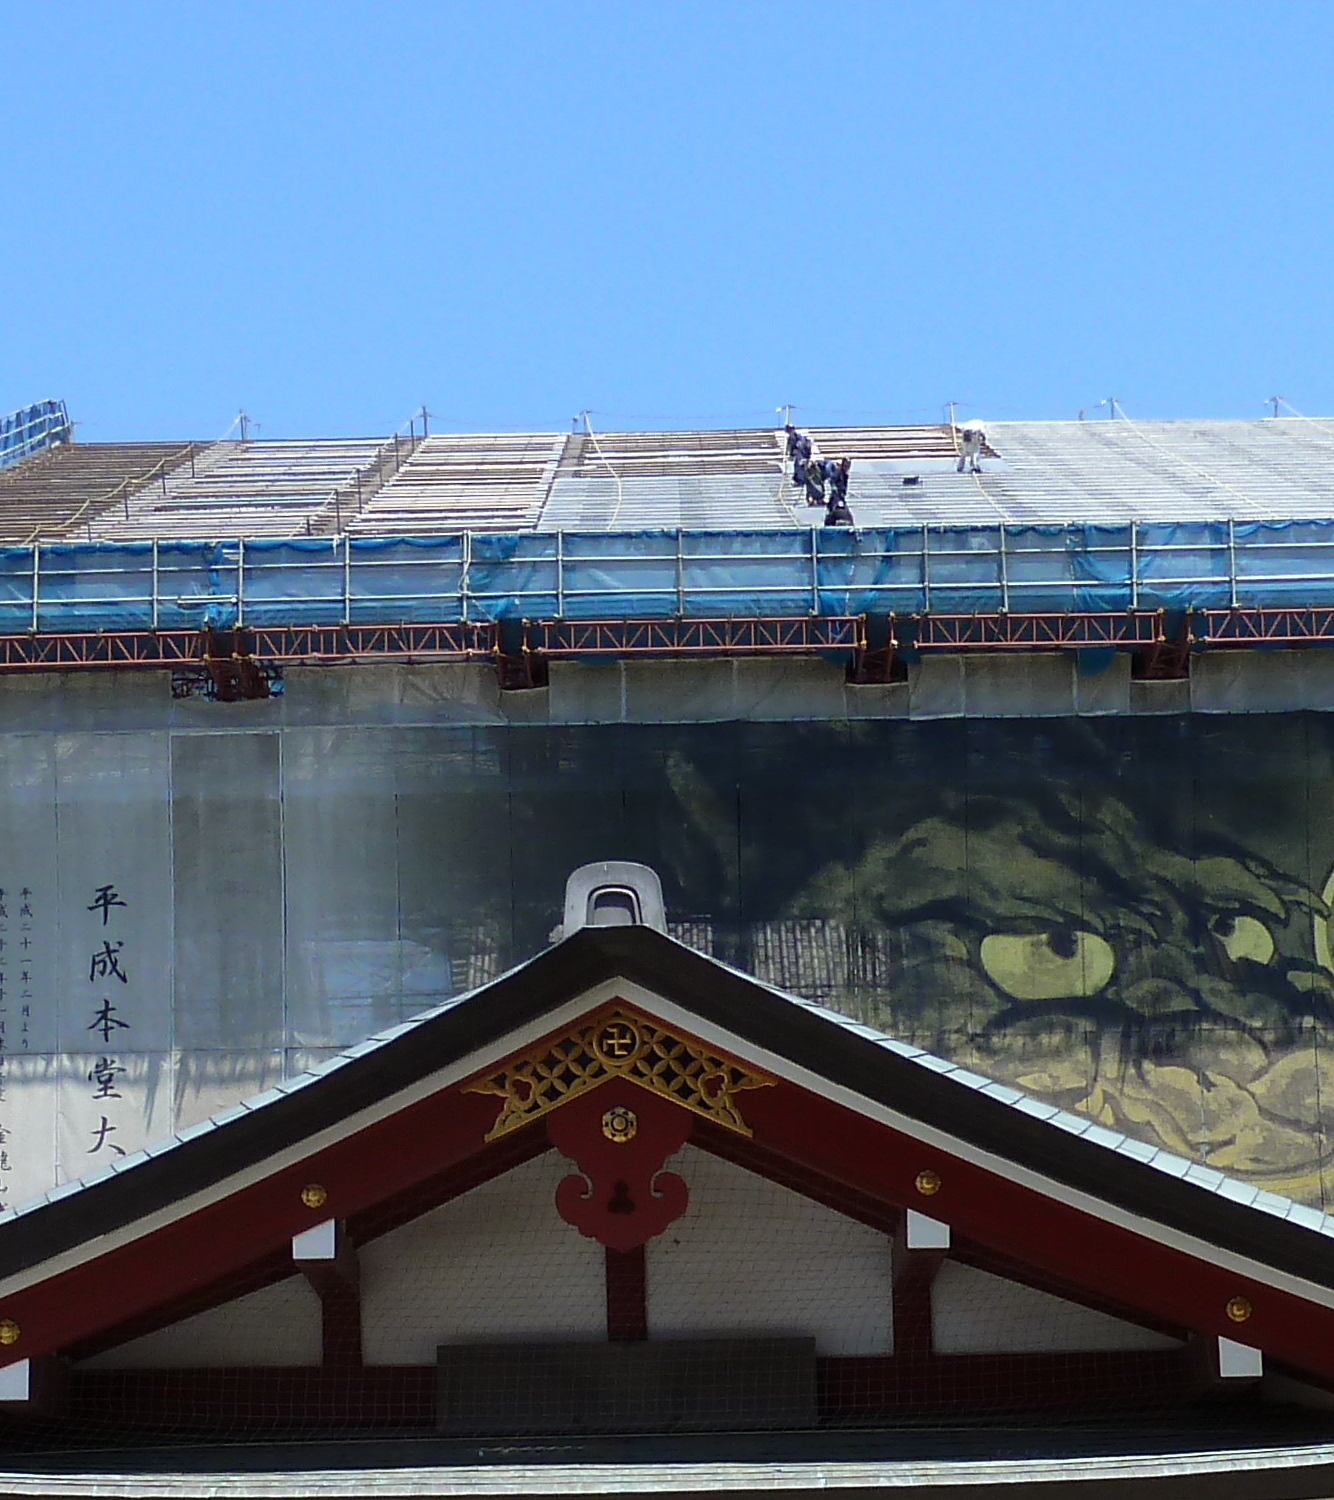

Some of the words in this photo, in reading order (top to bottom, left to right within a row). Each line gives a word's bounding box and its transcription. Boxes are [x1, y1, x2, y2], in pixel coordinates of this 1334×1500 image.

[19, 887, 34, 1049] 平成二十一年二月より
[87, 884, 130, 1156] 平成本堂大
